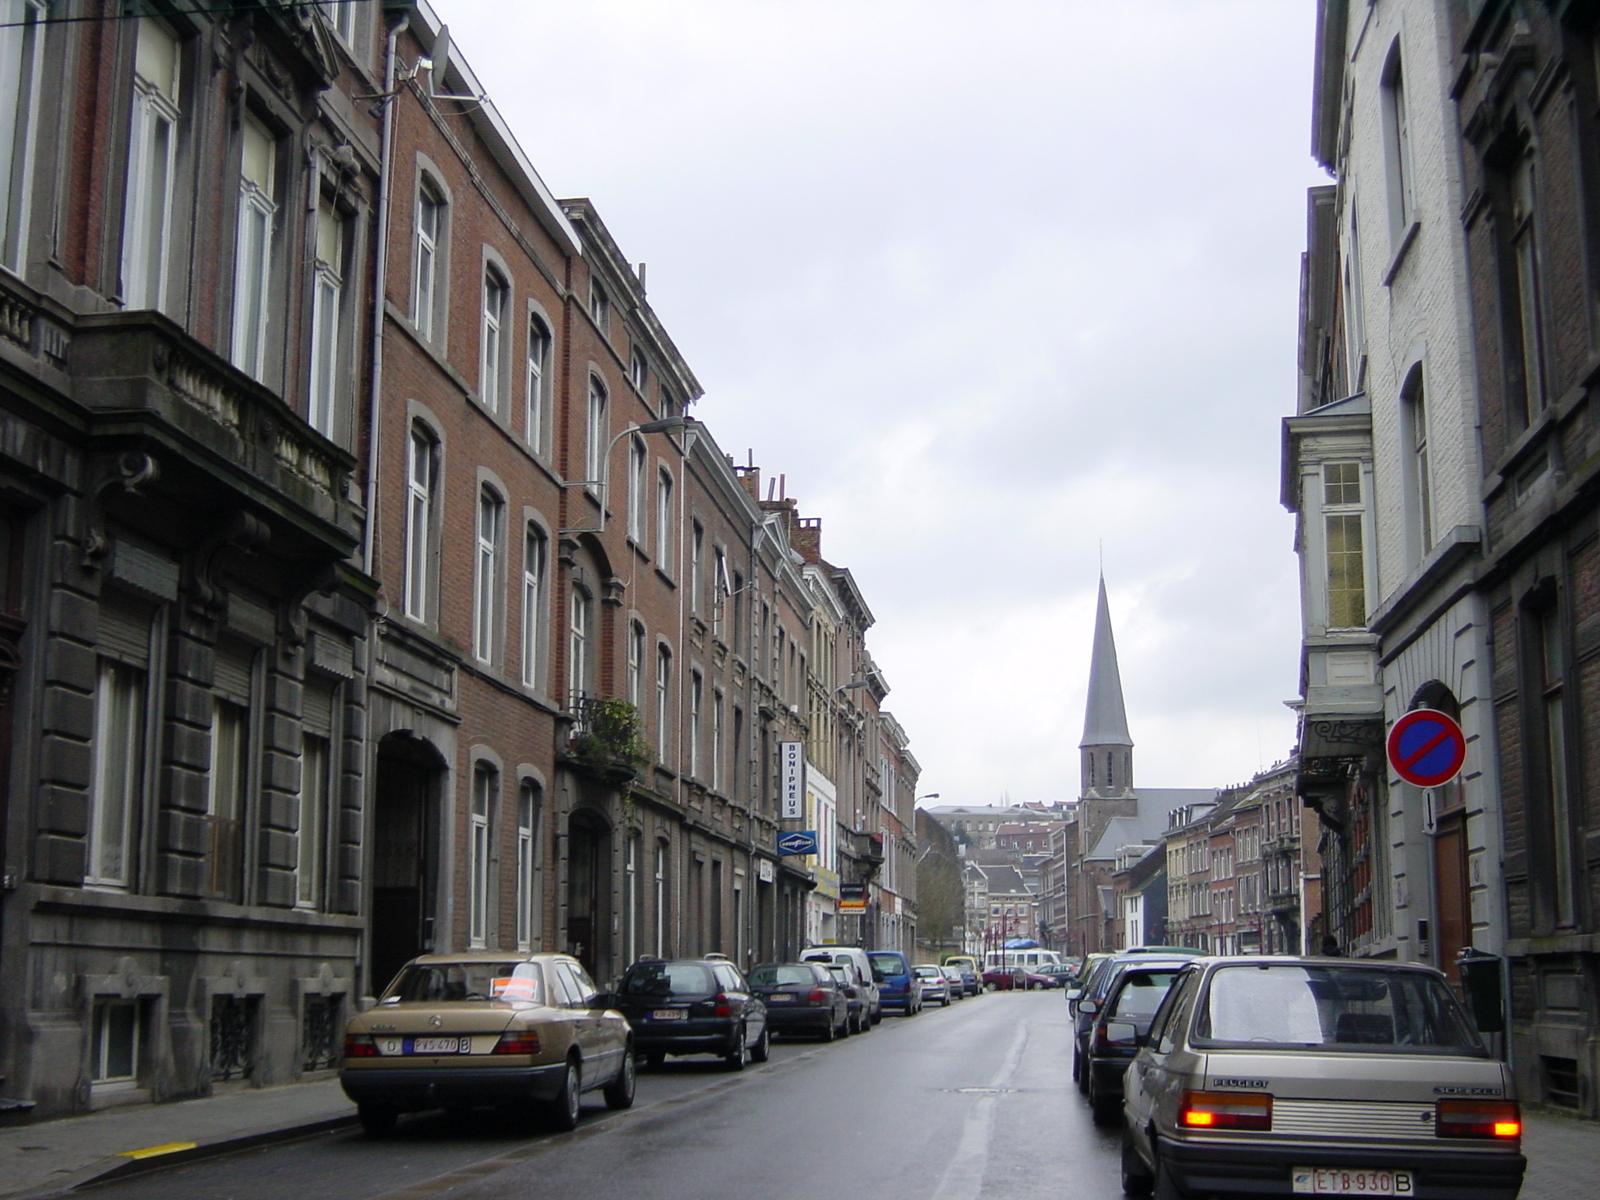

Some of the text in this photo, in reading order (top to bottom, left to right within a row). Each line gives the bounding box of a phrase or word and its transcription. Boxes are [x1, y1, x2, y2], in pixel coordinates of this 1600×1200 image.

[788, 744, 796, 815] BONIPNEUS
[461, 1039, 469, 1051] B
[1213, 1079, 1268, 1089] PEUGEOT
[1395, 1174, 1412, 1192] B
